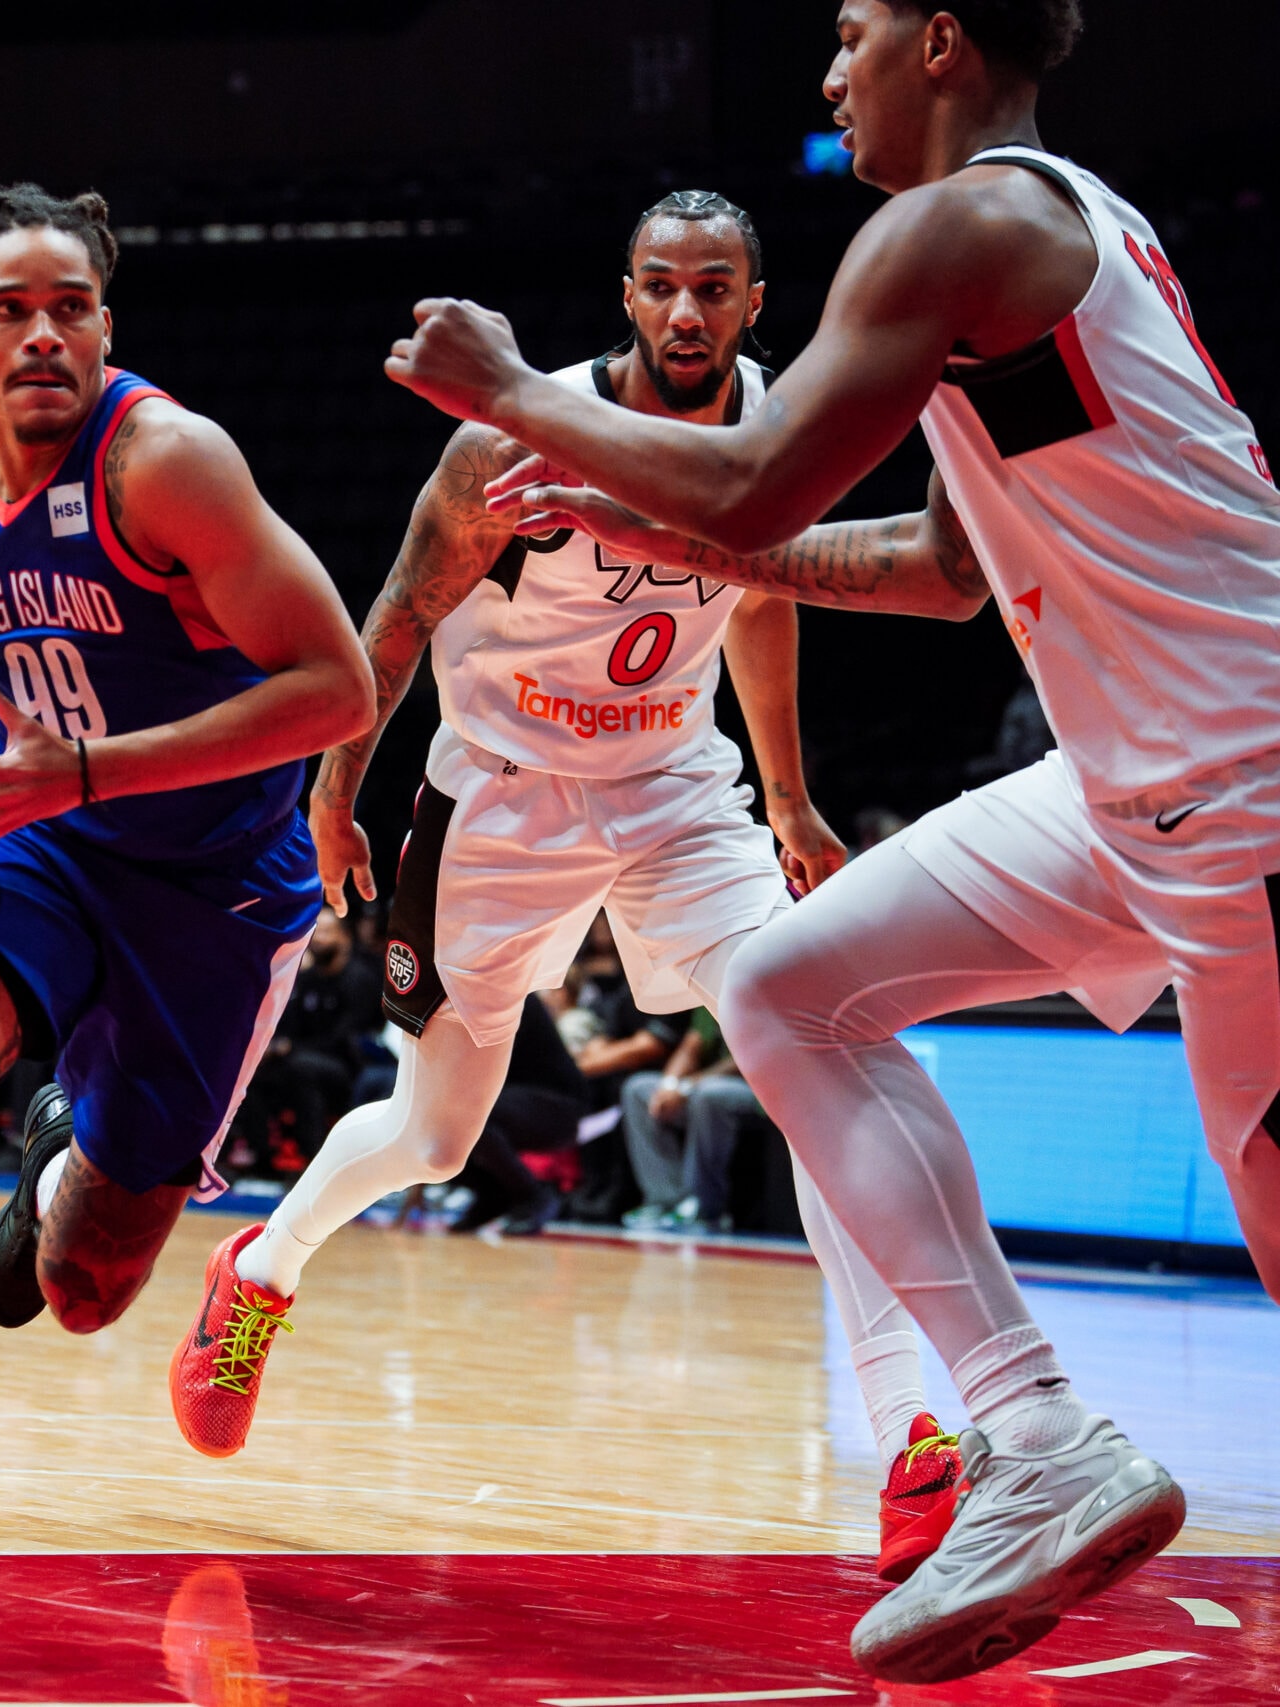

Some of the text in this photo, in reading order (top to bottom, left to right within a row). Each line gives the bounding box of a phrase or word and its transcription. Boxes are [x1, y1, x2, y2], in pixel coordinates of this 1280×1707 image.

[53, 501, 83, 519] HSS
[9, 569, 124, 635] ISLAND
[607, 611, 676, 686] 0
[4, 637, 107, 741] 99
[514, 672, 684, 739] Tangerine
[390, 957, 412, 984] 905
